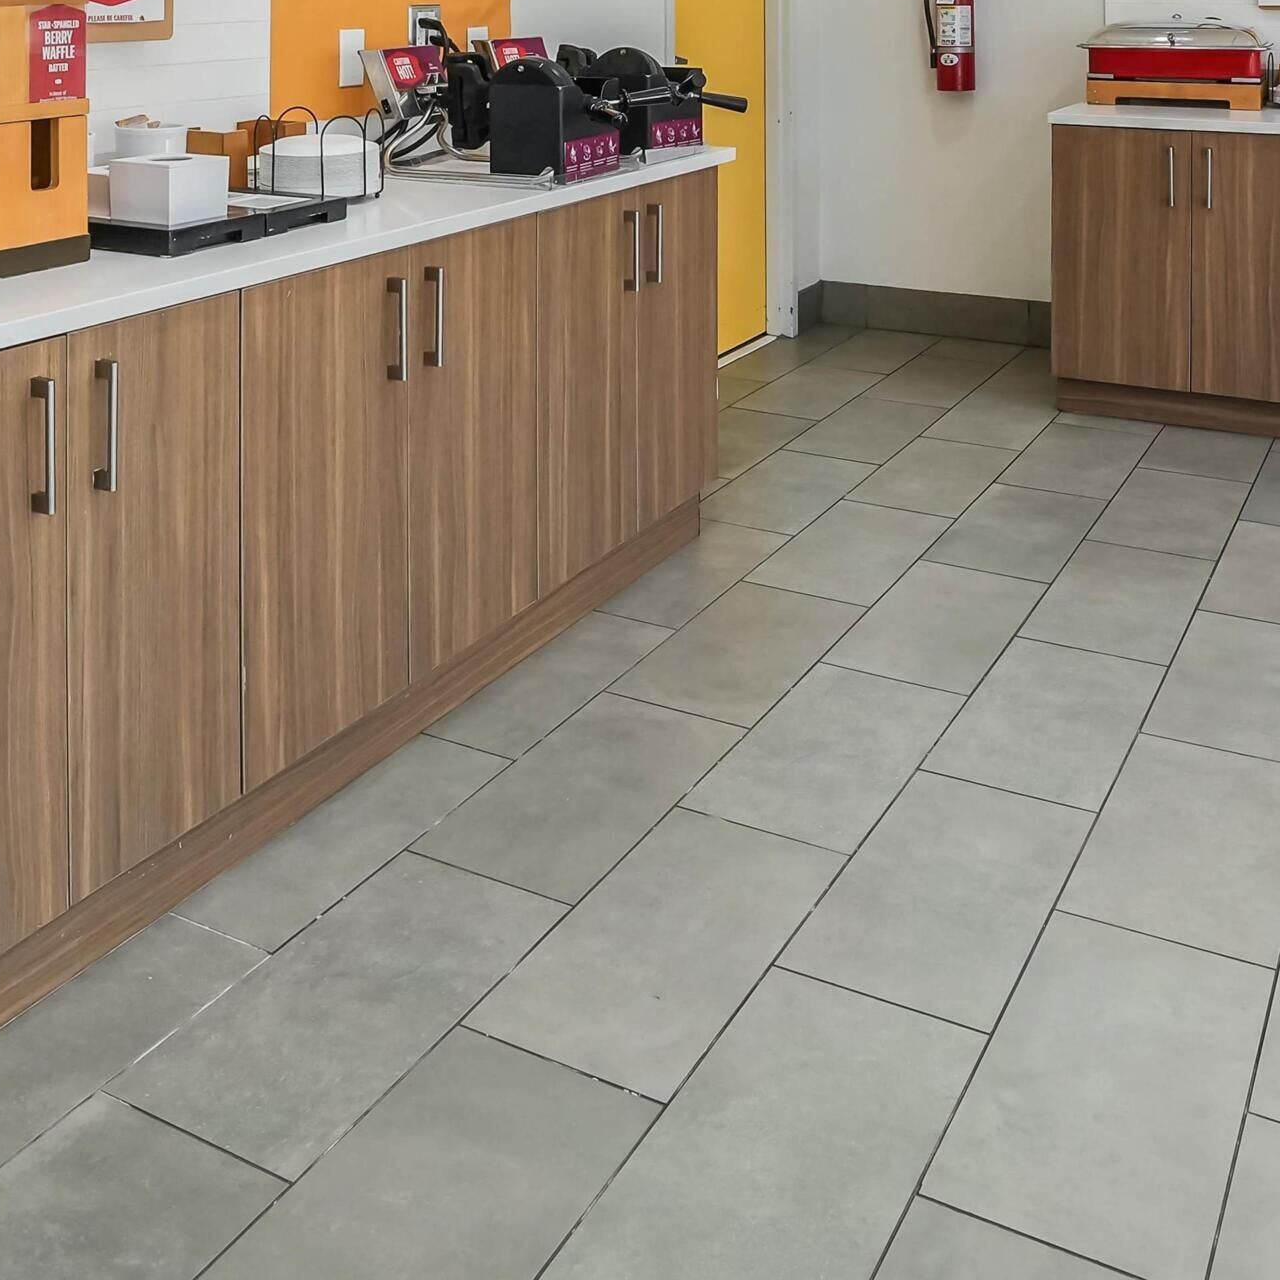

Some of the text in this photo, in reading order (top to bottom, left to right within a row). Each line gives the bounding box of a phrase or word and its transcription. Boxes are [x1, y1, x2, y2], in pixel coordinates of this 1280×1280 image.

[44, 30, 73, 45] BERRY
[42, 45, 76, 60] WAFFLE
[396, 65, 417, 80] HOT!
